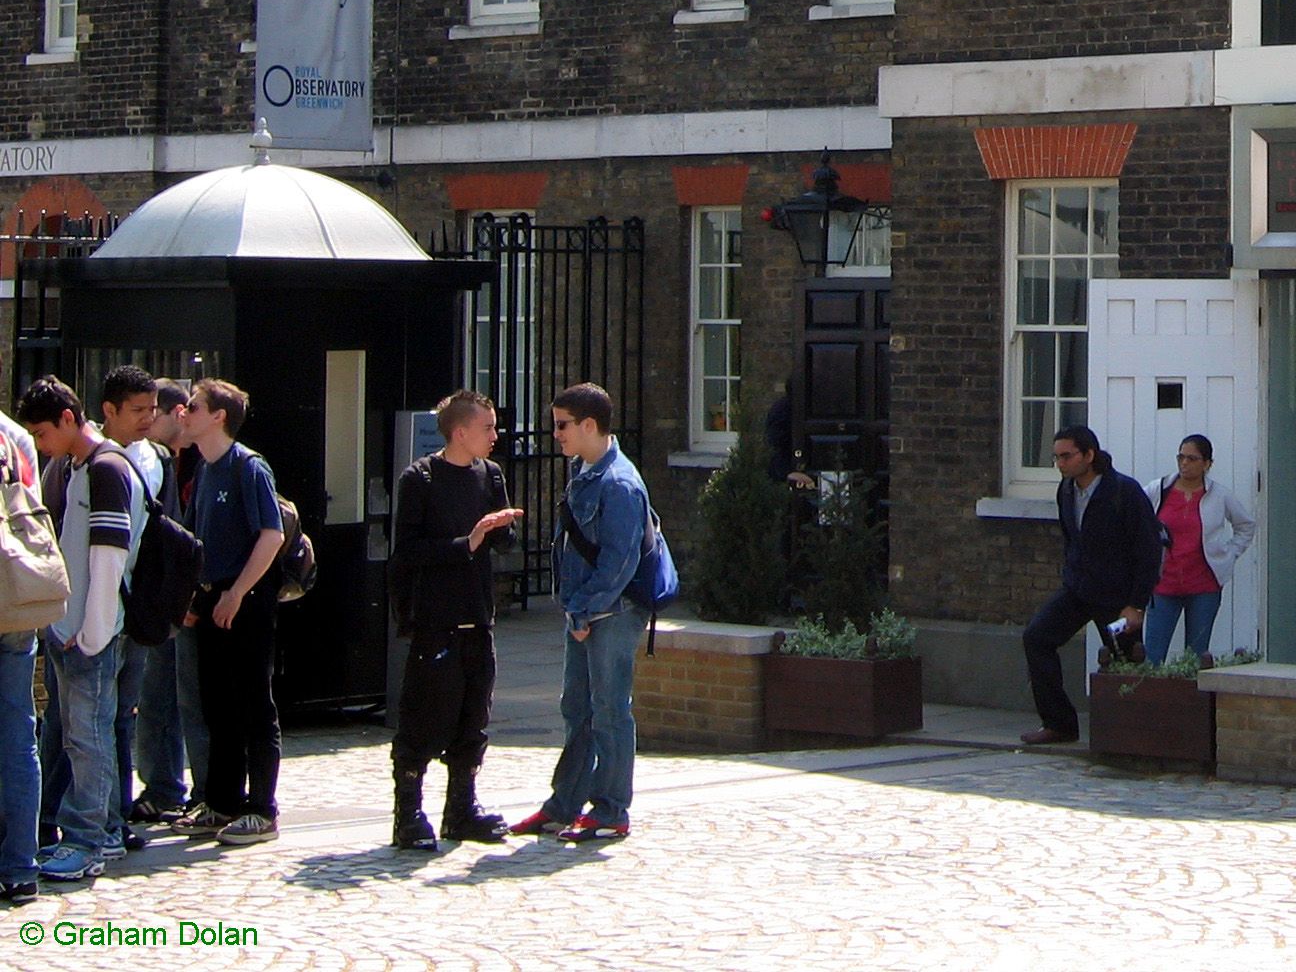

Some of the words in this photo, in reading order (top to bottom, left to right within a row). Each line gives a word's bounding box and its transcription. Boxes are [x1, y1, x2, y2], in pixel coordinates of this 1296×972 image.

[295, 66, 321, 78] ROYAL
[295, 96, 344, 109] GREENWICH
[0, 145, 58, 172] ATORY
